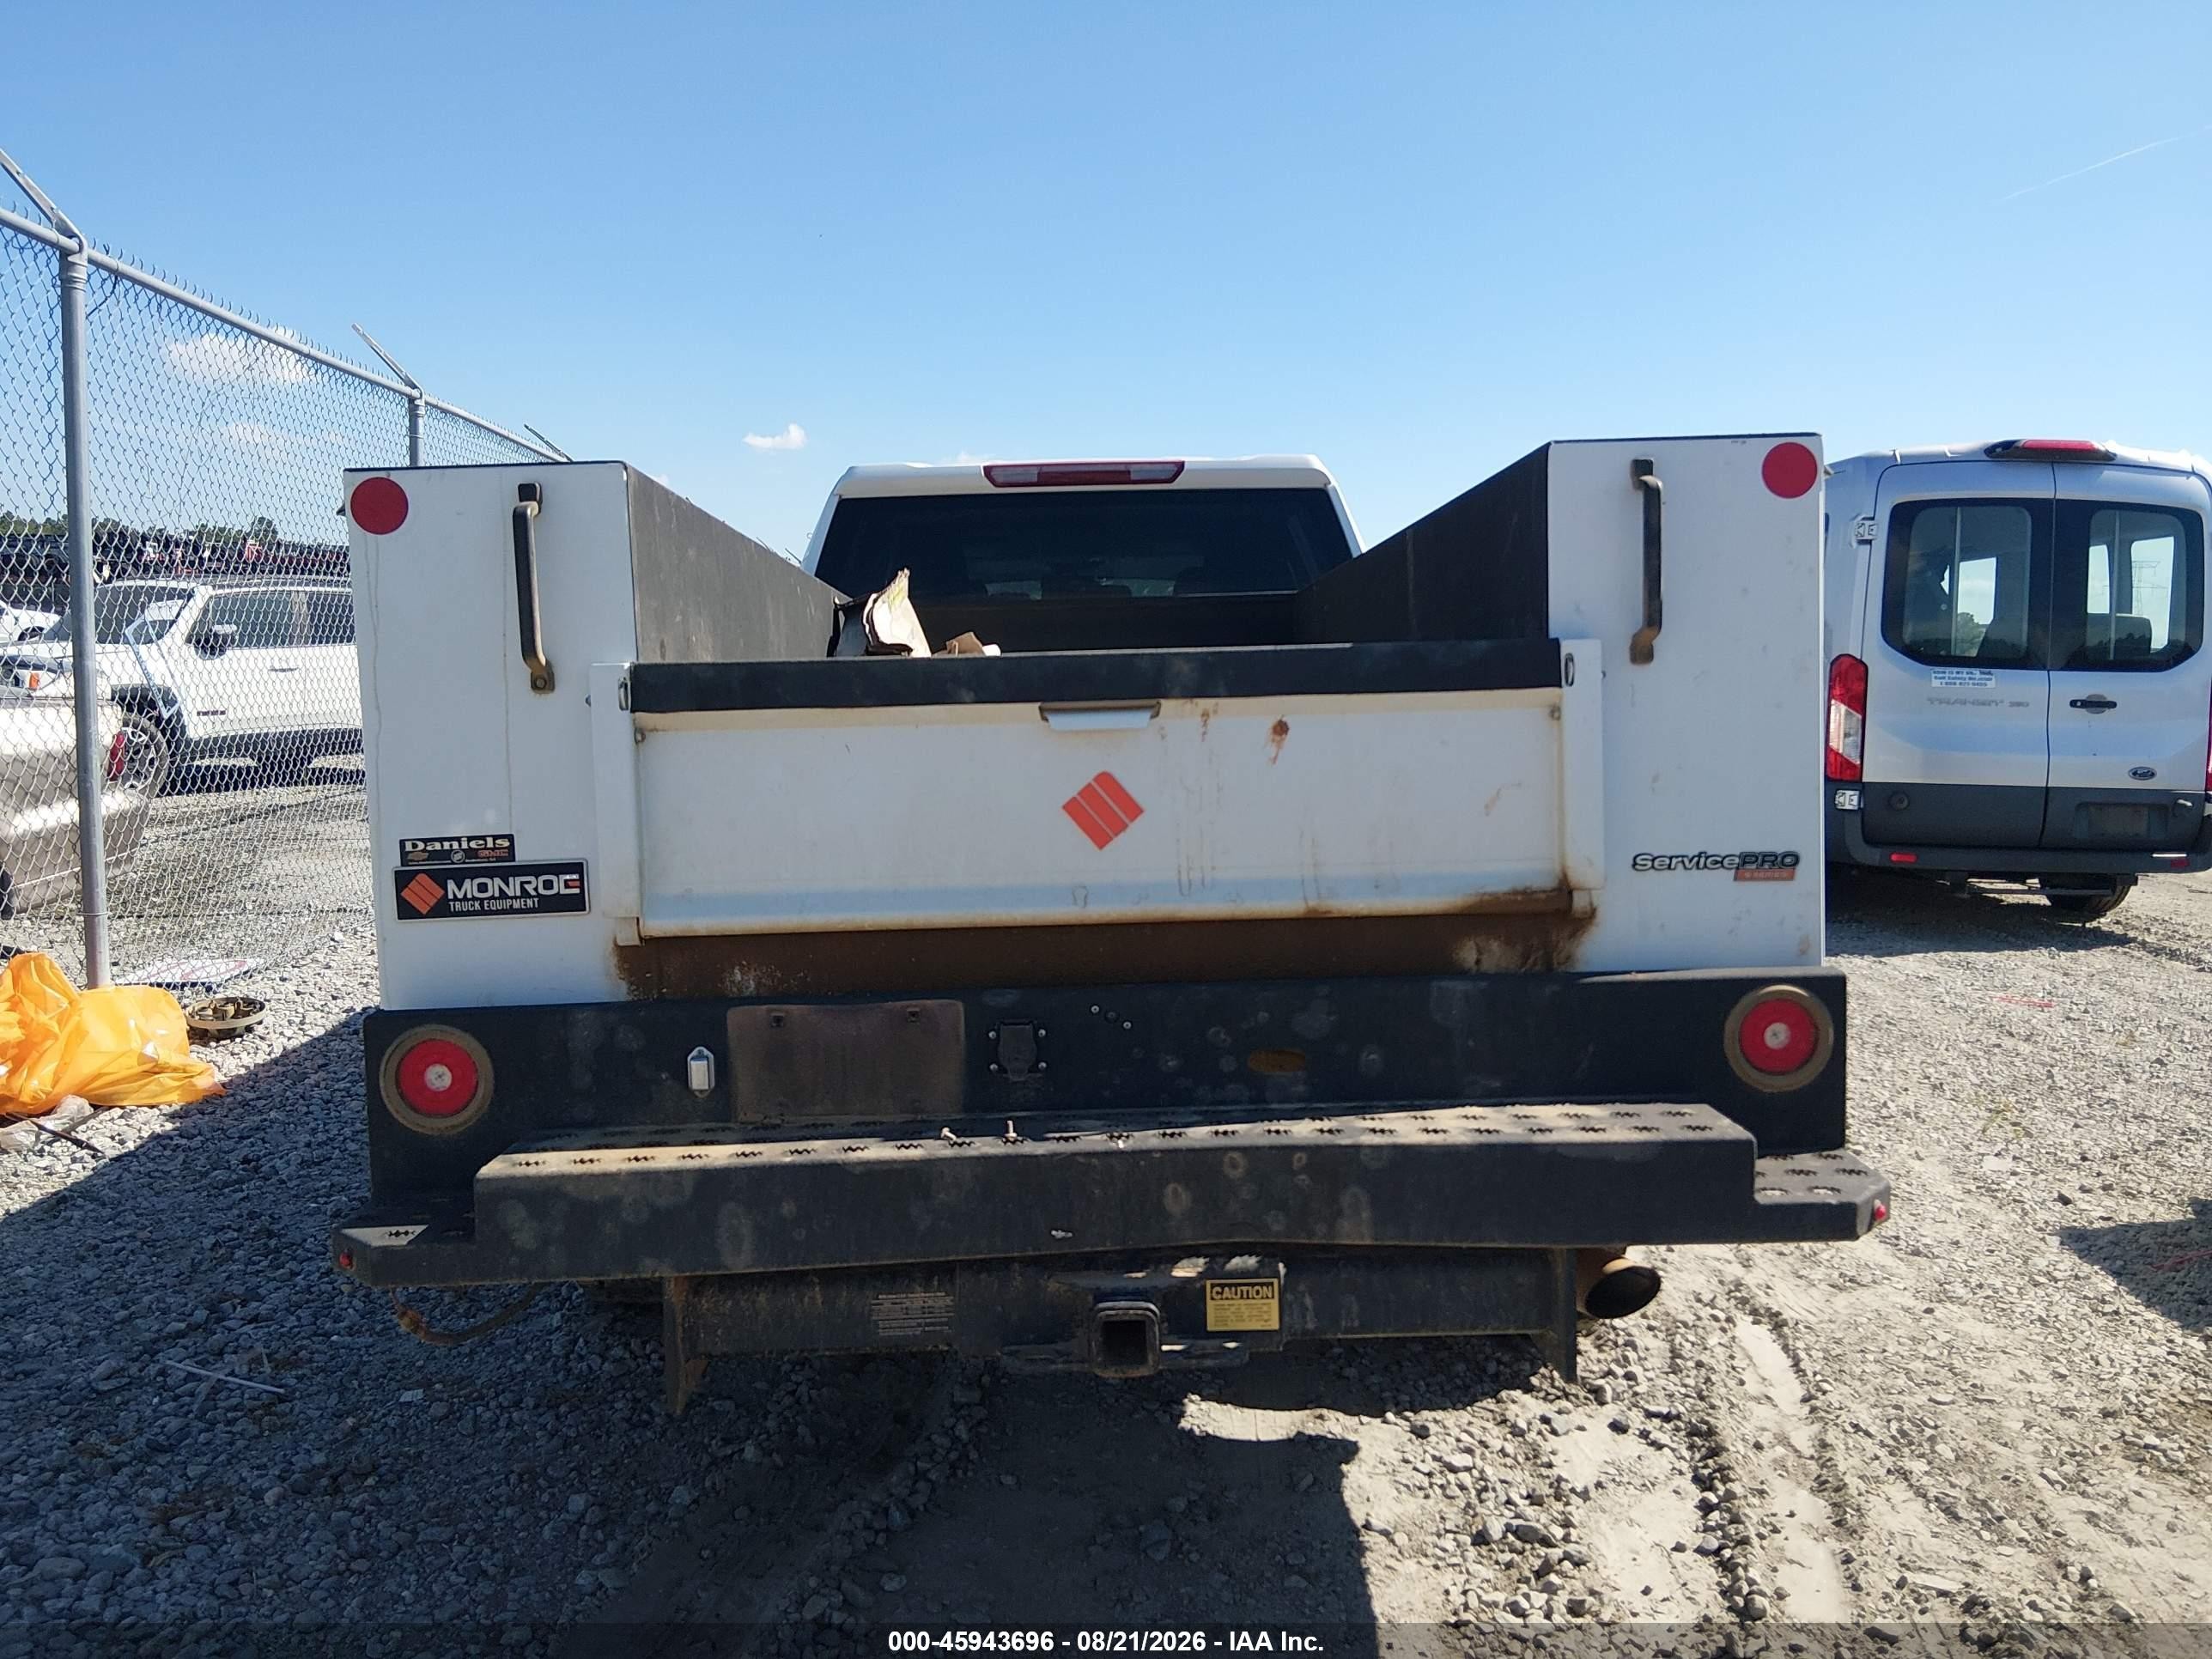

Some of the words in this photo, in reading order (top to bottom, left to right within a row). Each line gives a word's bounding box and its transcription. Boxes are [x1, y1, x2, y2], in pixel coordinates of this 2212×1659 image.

[404, 837, 510, 852] Daniels
[1632, 851, 1801, 871] ServicePRO
[447, 873, 580, 899] MONROE
[449, 901, 481, 912] TRUCK
[483, 897, 539, 910] EQUIPMENT
[1212, 1285, 1272, 1299] CAUTION
